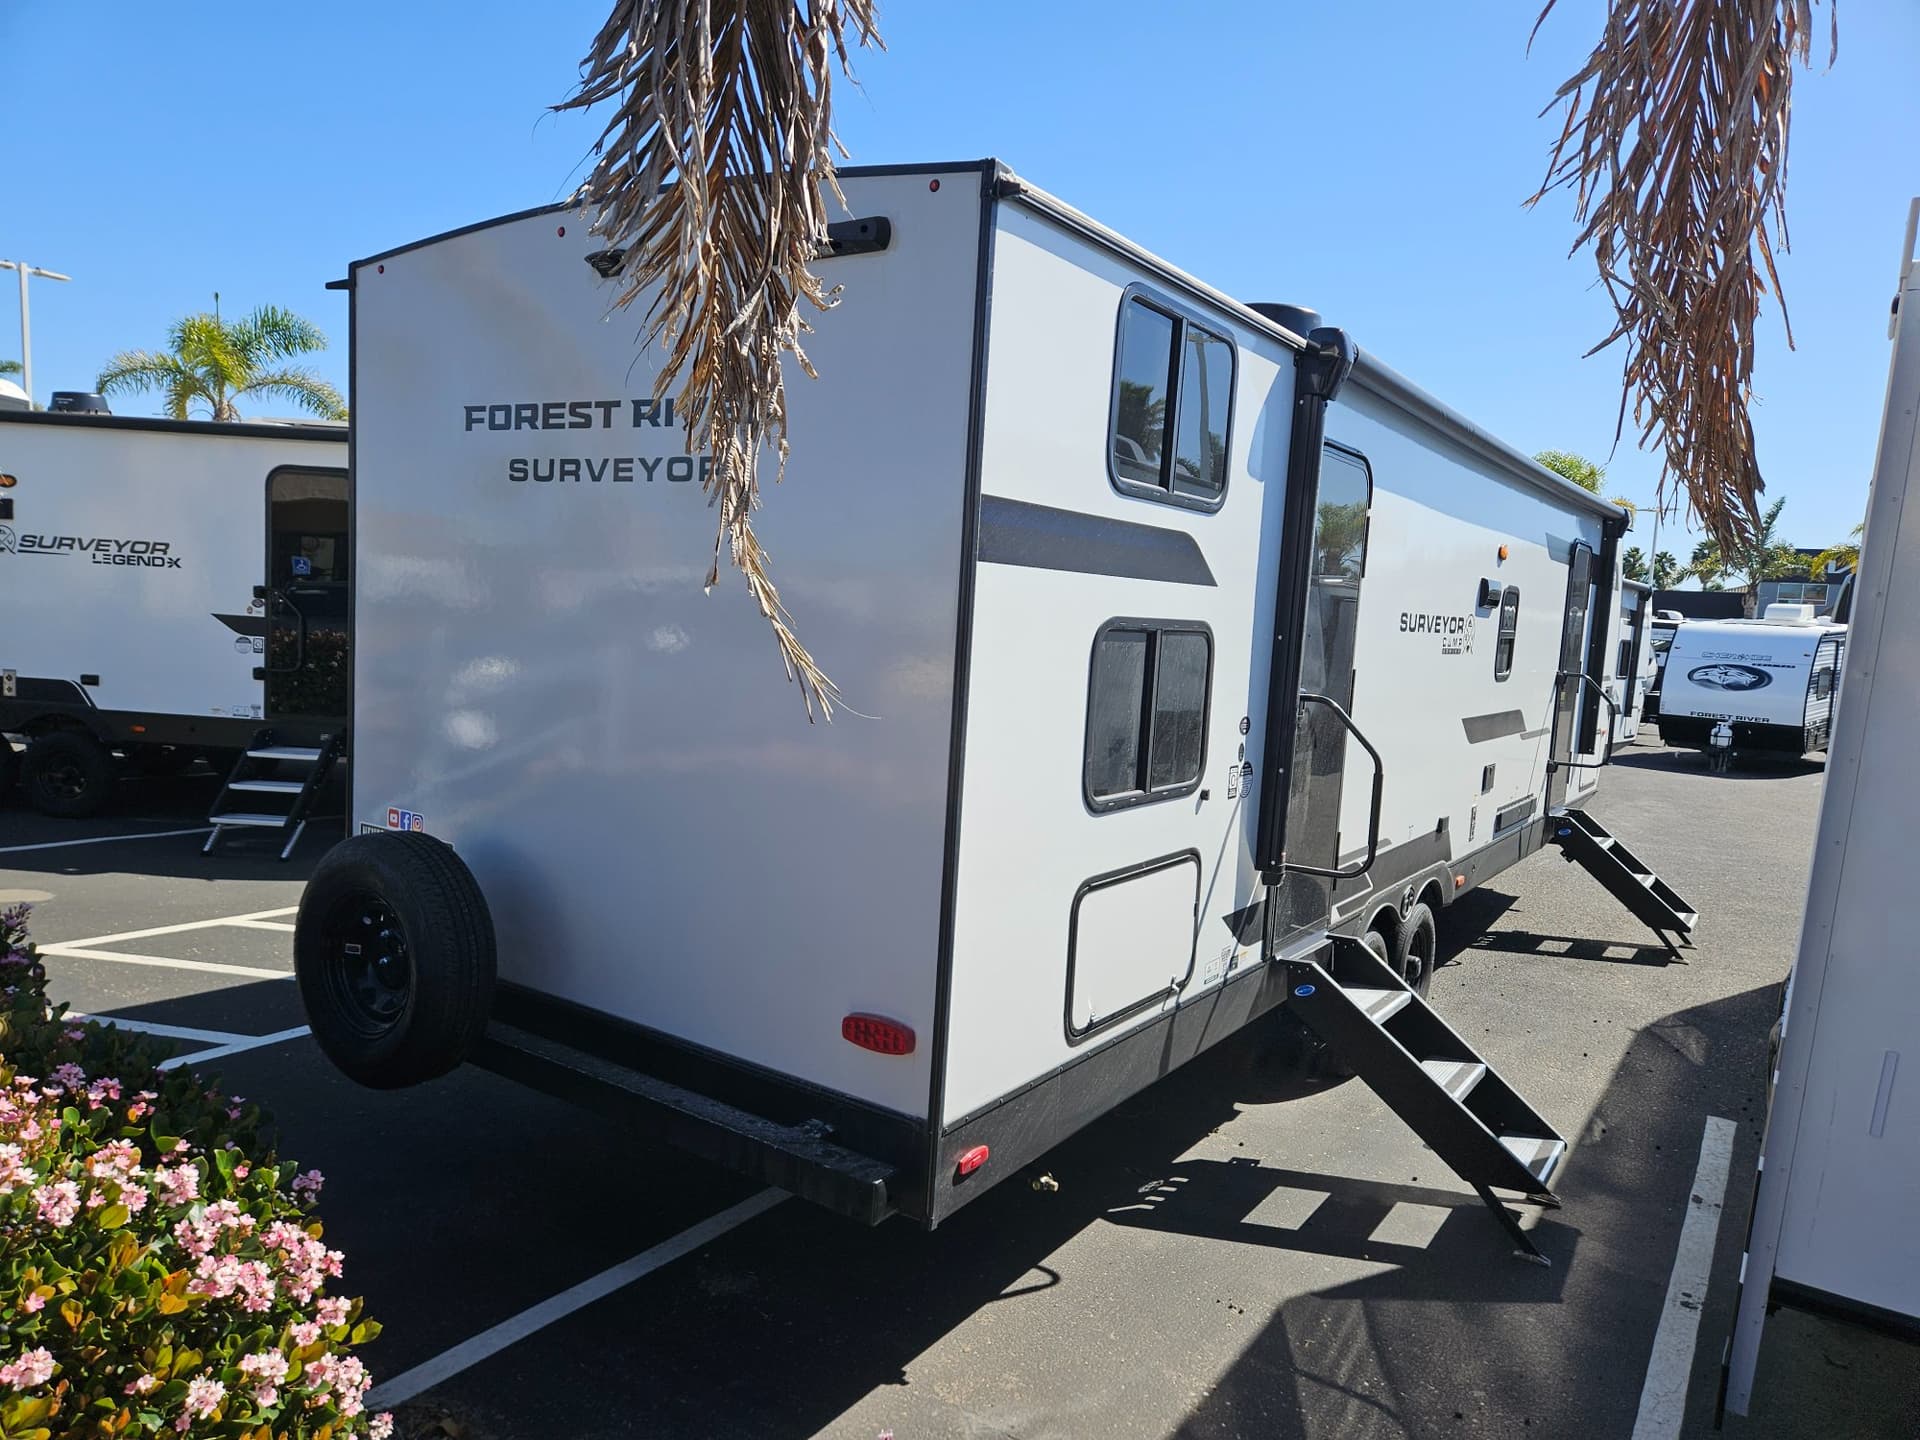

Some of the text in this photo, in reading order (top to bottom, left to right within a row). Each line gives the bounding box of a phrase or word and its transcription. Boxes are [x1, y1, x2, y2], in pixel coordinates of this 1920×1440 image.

[464, 400, 622, 432] FOREST
[508, 456, 721, 483] SURVEYOR
[19, 534, 171, 556] SURVEYOR
[1400, 613, 1464, 634] SURVEYOR
[1690, 711, 1770, 723] FOREST RIVER
